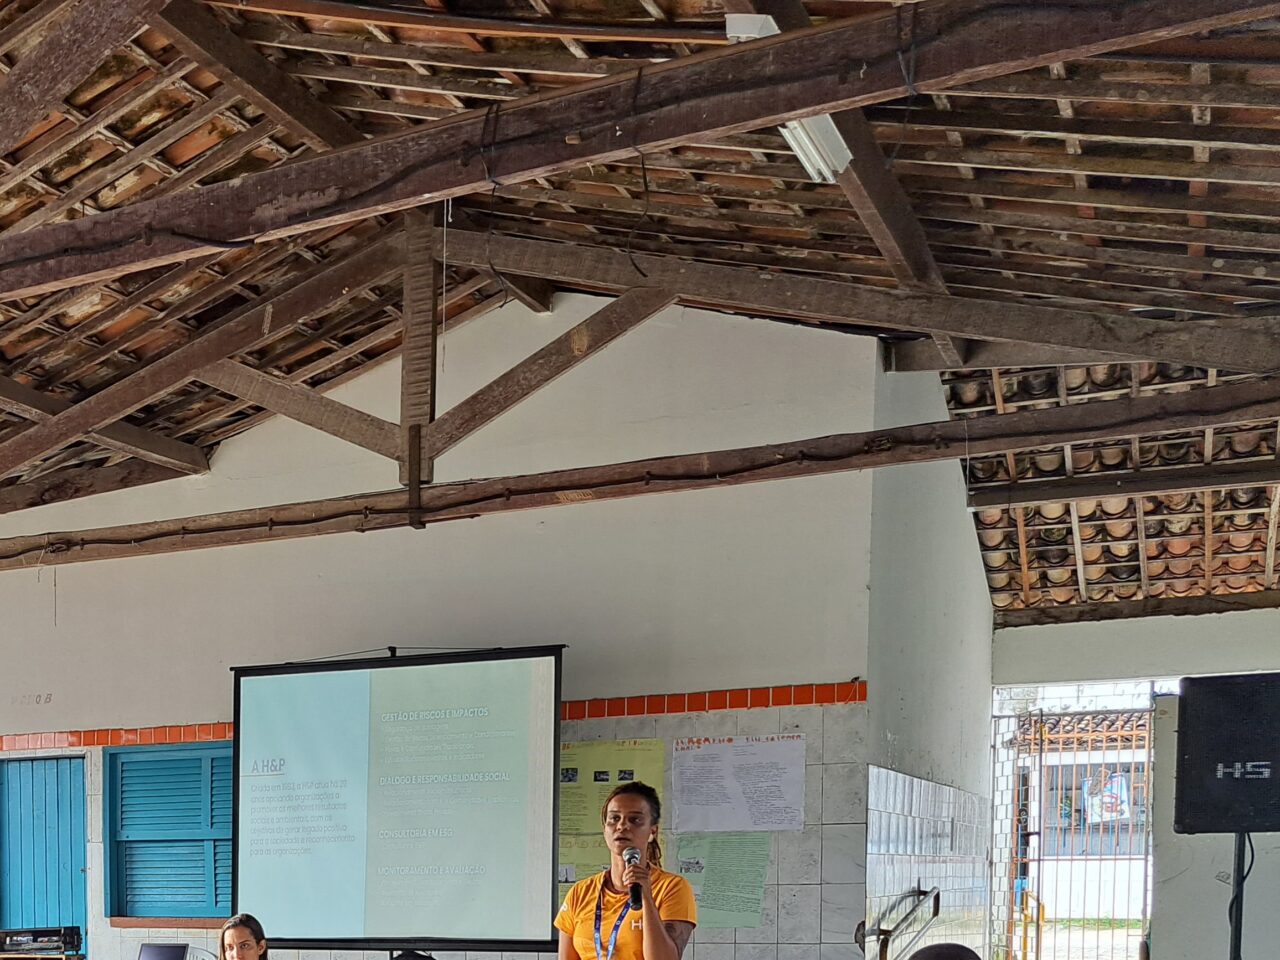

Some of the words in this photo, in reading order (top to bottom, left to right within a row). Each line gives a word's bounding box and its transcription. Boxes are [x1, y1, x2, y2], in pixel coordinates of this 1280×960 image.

[381, 711, 407, 723] GESTÃO
[409, 711, 419, 721] DE
[420, 710, 445, 721] RISCOS
[451, 707, 489, 719] IMPACTOS
[251, 759, 259, 774] A
[261, 758, 286, 773] H&P
[1216, 761, 1271, 779] HS
[418, 773, 484, 785] RESPONSABILIDADE
[484, 771, 511, 782] SOCIAL
[378, 828, 428, 840] CONSULTORIA
[439, 827, 454, 838] ESG
[378, 866, 439, 876] MONITORAMENTO
